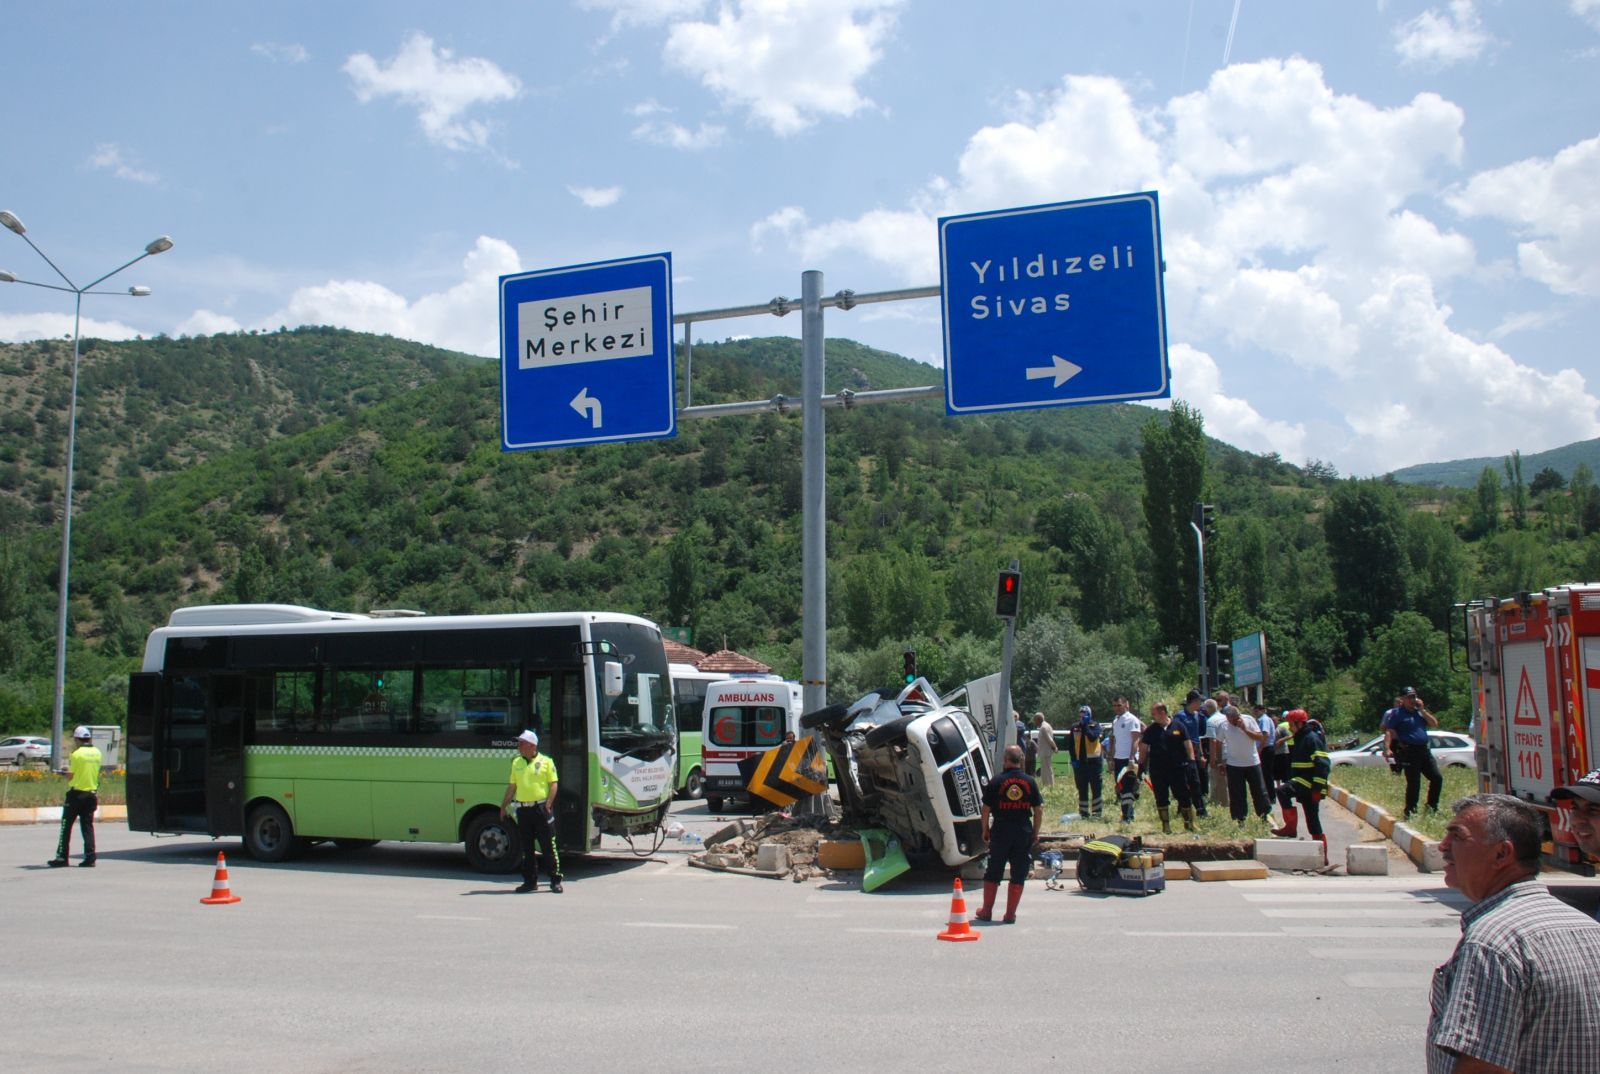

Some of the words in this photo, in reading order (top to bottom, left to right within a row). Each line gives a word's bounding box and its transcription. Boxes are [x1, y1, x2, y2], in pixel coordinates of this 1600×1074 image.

[970, 244, 1135, 284] Yıldızeli
[543, 302, 625, 333] Şehir
[971, 293, 1071, 320] Sivas
[526, 327, 647, 360] Merkezi
[717, 693, 775, 703] AMBULANS
[1565, 654, 1580, 783] İTFAİY
[1514, 732, 1544, 748] İTFAİYE
[1517, 751, 1542, 780] 110
[959, 782, 970, 797] AAT
[963, 797, 974, 814] 262
